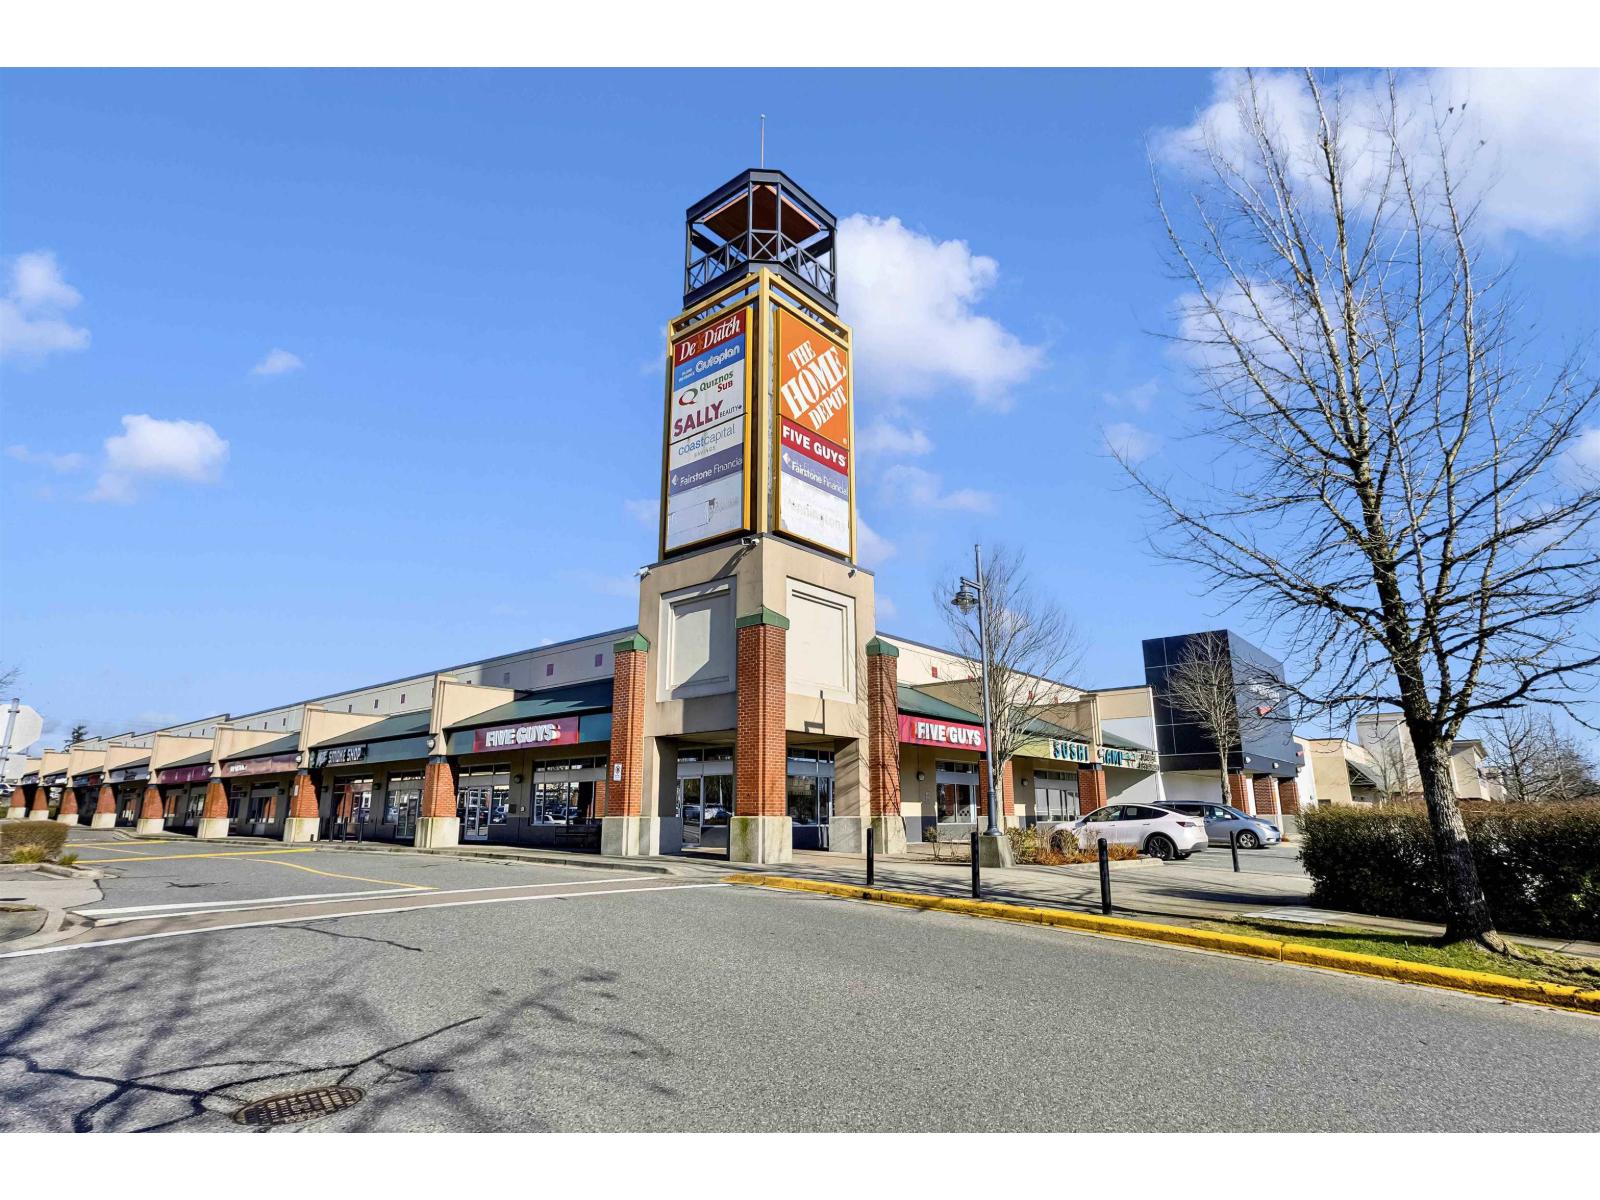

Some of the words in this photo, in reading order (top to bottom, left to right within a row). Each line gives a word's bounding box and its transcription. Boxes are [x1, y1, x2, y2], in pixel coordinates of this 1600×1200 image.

[679, 341, 697, 362] De
[703, 315, 741, 349] Dutch
[787, 340, 816, 371] THE
[780, 346, 847, 420] HOME
[673, 400, 724, 437] SALLY
[720, 405, 739, 418] BEAUTY
[808, 385, 847, 431] DEPOT
[783, 425, 811, 450] FIVE
[813, 442, 846, 467] GUYS
[680, 468, 713, 486] Fairstone
[713, 457, 743, 474] Financia
[791, 461, 823, 484] Fairstone
[485, 728, 516, 747] FIVE
[516, 723, 560, 744] GUYS
[916, 721, 947, 742] FIVE
[948, 726, 982, 746] GUYS
[1053, 740, 1089, 762] SUSHI
